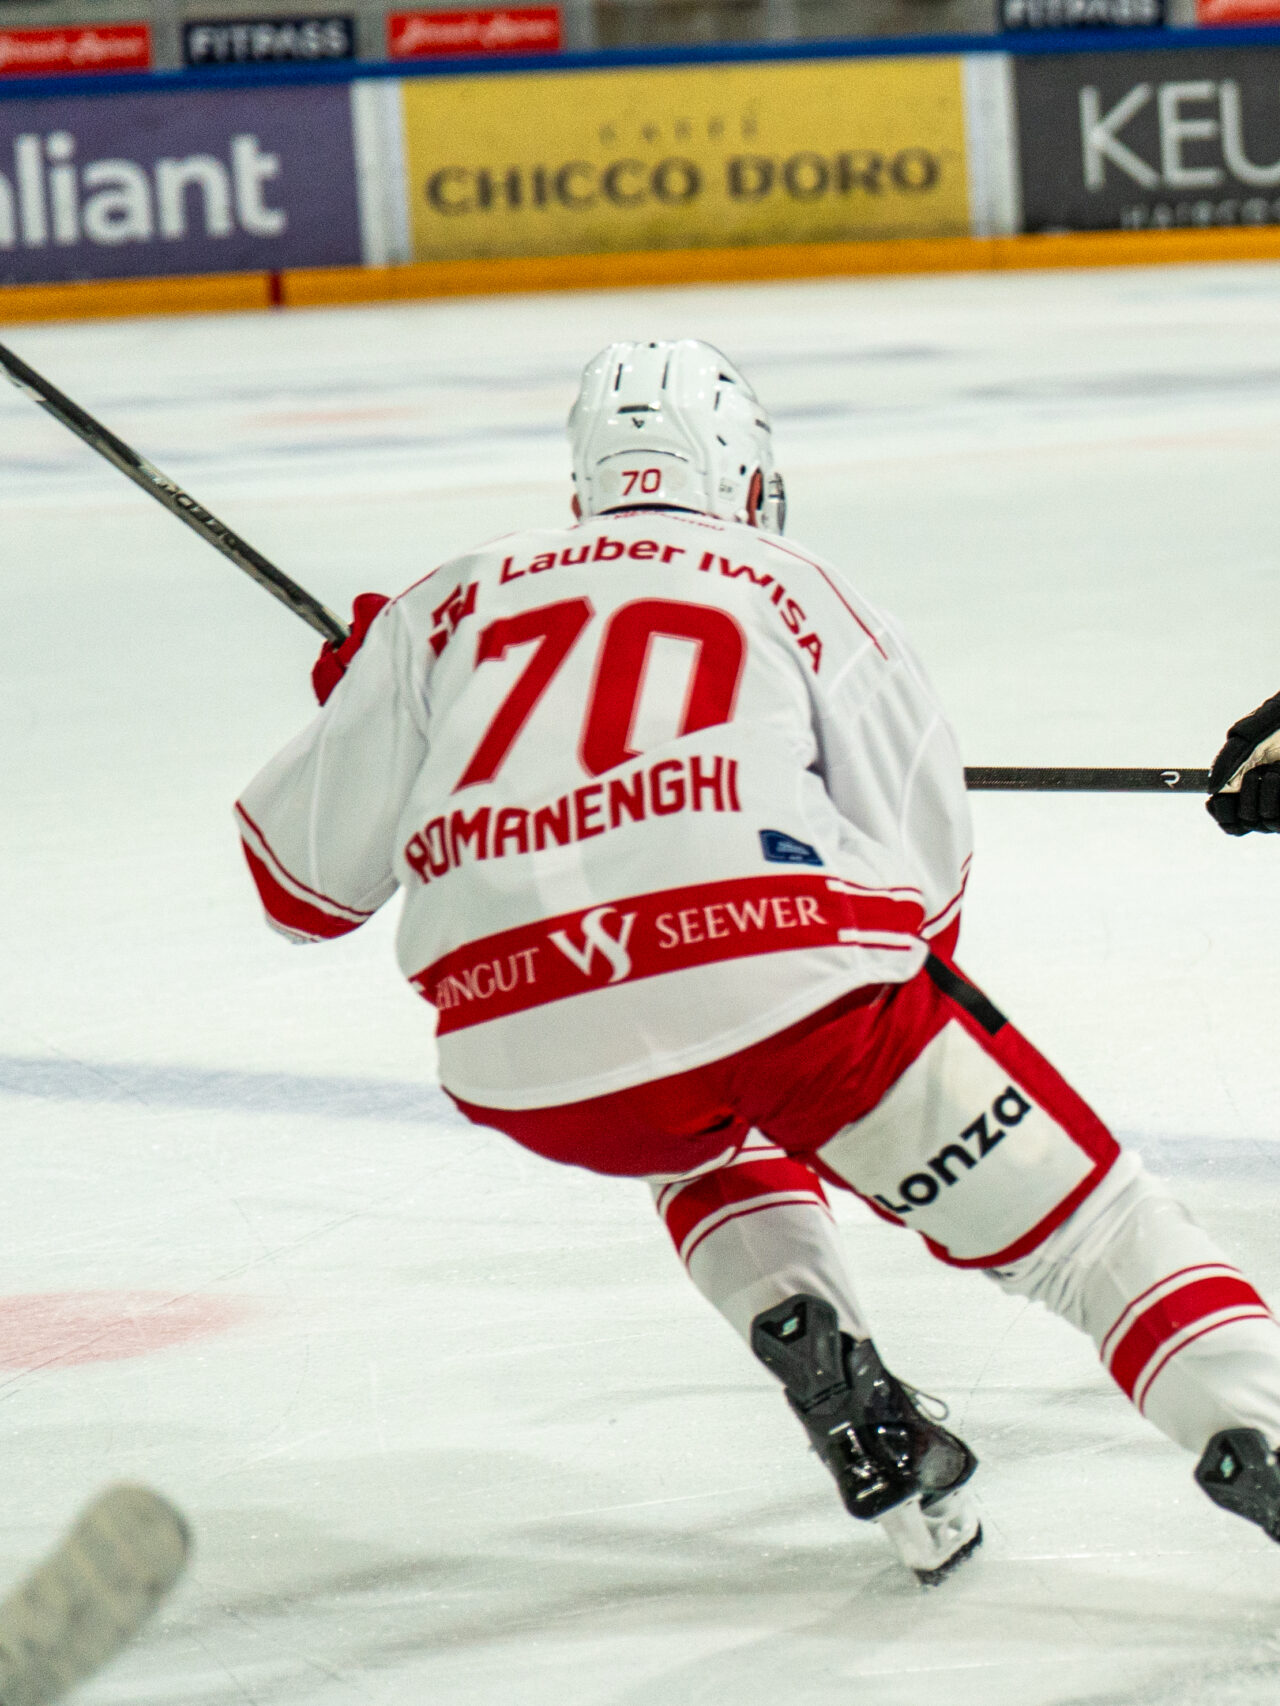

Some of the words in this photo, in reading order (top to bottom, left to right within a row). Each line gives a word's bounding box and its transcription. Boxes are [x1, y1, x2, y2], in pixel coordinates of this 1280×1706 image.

[0, 131, 287, 250] liant
[425, 157, 702, 216] CHICCO
[621, 468, 662, 496] 70
[499, 536, 686, 586] Lauber
[698, 550, 824, 674] IWISA
[451, 595, 748, 795] 70
[404, 755, 742, 885] ROMANENGHI
[654, 896, 826, 950] SEEWER
